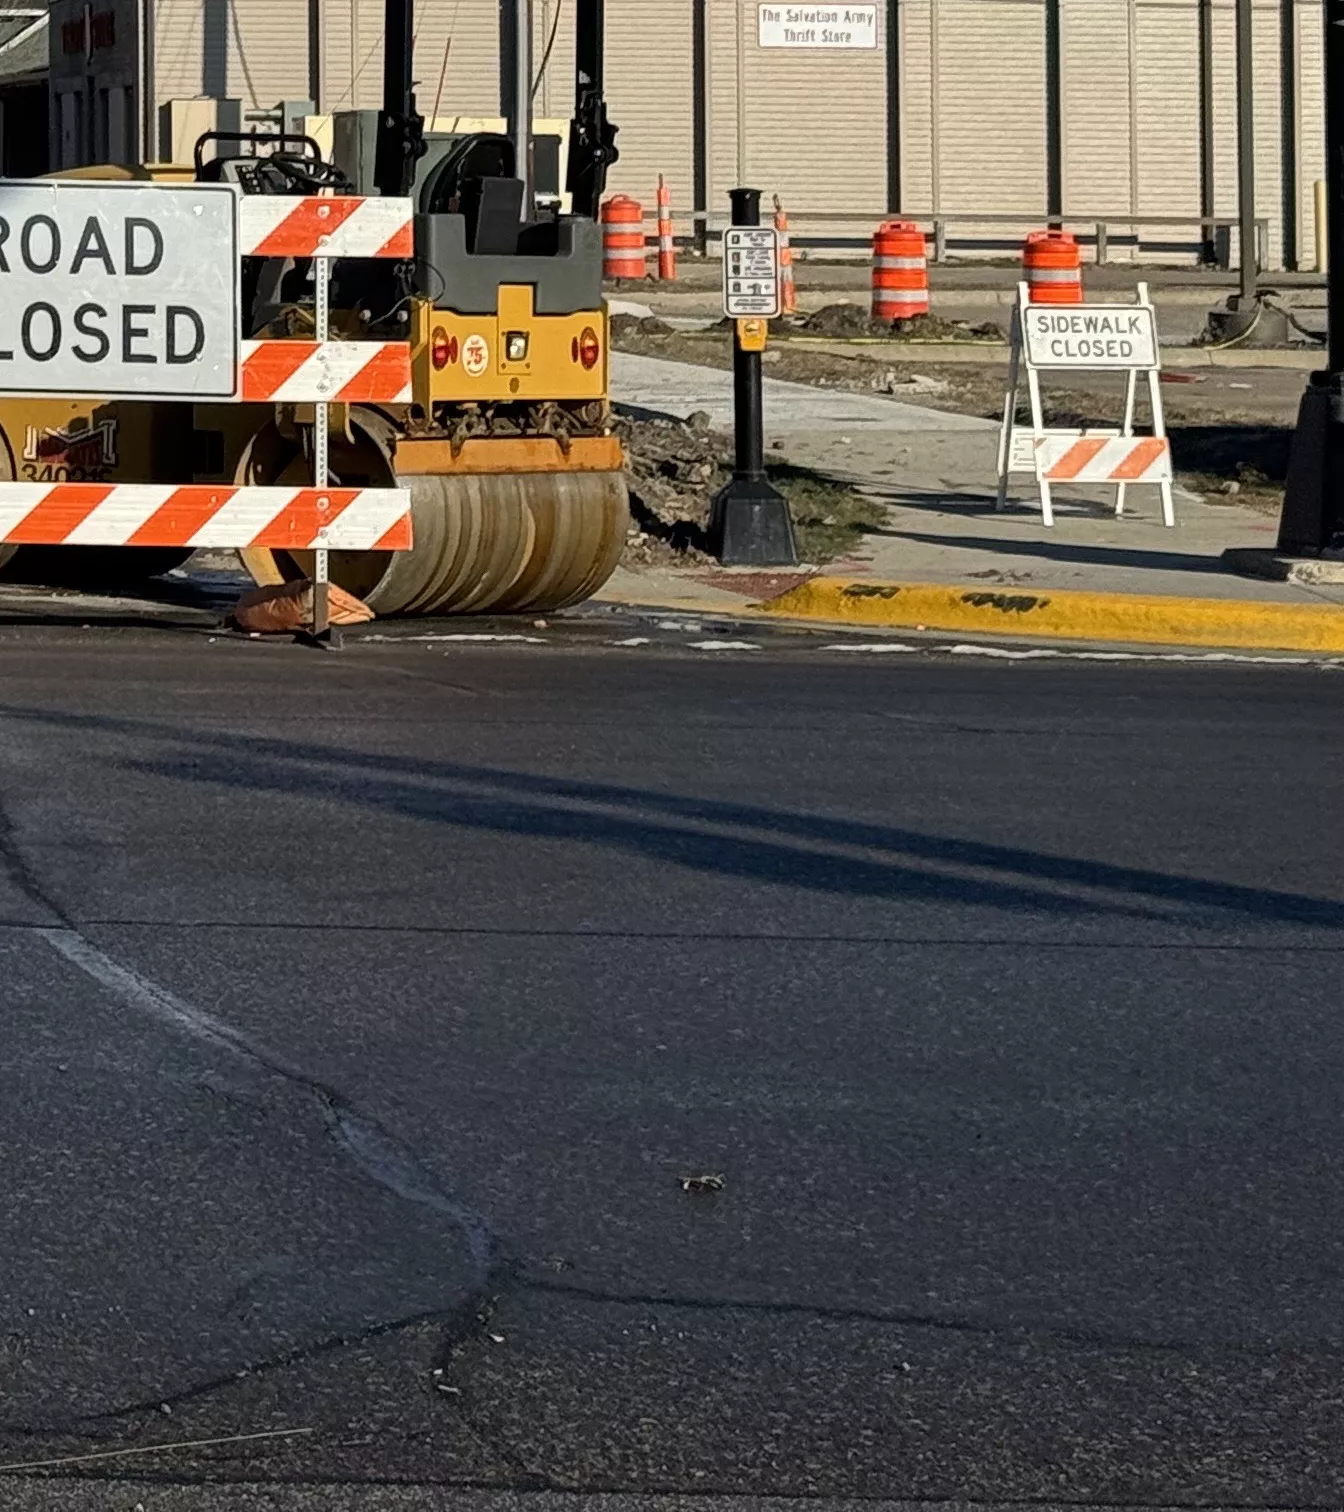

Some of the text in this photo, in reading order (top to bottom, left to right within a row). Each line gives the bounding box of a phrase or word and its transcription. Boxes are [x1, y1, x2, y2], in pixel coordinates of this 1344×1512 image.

[762, 9, 873, 27] The Salvation Army
[784, 28, 852, 43] Thrift Store
[1037, 316, 1142, 334] SIDEWALK
[1051, 340, 1133, 357] CLOSED
